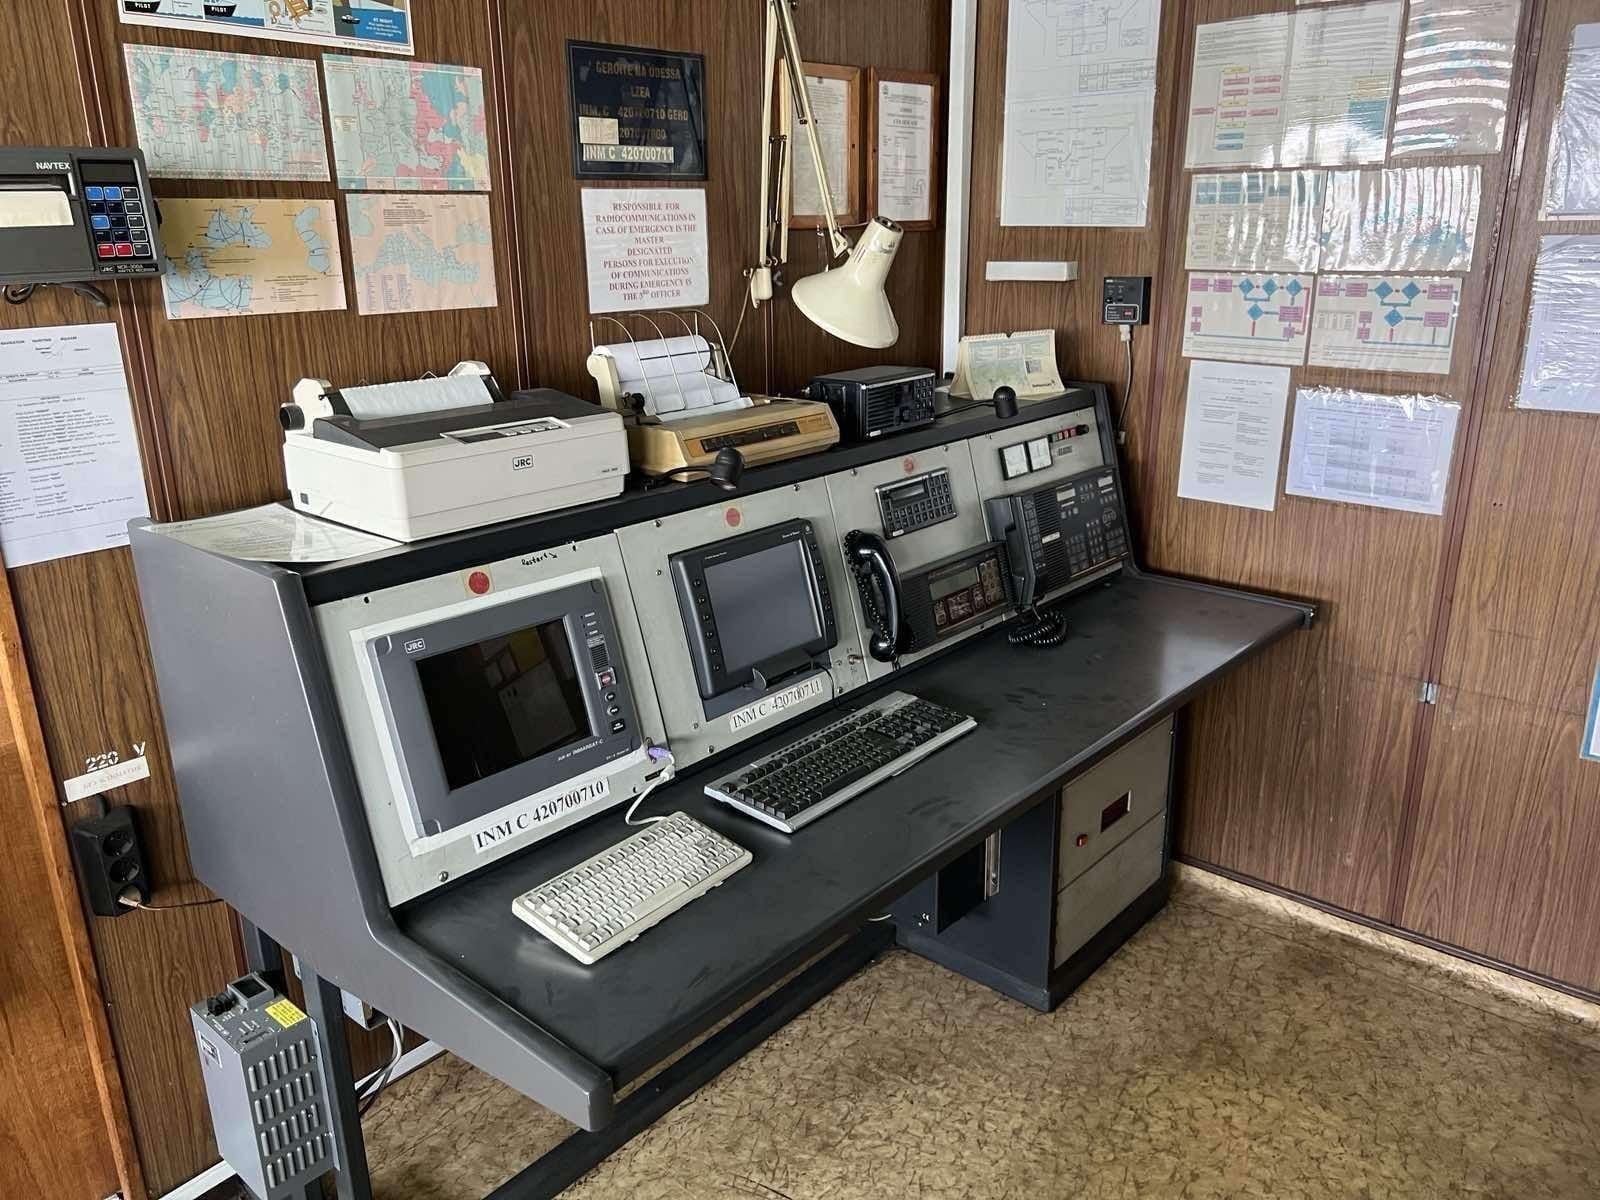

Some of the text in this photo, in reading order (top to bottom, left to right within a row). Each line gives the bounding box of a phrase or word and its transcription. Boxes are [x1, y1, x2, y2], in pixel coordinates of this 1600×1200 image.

[649, 66, 681, 80] ODESSA
[585, 145, 673, 161] INM C 420700711
[35, 162, 72, 170] NAVTEX
[612, 202, 680, 211] RESPONSIBLE FOR
[595, 213, 688, 223] RADIOCOMMUNICATIONS
[595, 223, 696, 235] CASE OF EMERGENCY IS THE
[635, 236, 665, 244] MASTER
[627, 246, 673, 256] DESIGNATED
[603, 256, 695, 268] PERSONS FOR EXECUTION
[611, 267, 689, 280] OF COMMUNICATIONS
[609, 281, 639, 291] DURING
[640, 279, 684, 289] EMERGENCY
[623, 292, 639, 301] THE
[650, 289, 681, 299] OFFICER
[514, 458, 531, 467] JRC
[520, 552, 548, 566] Restart
[407, 641, 423, 651] JRC
[733, 680, 821, 728] INM C 420700711
[85, 741, 146, 773] 220 V
[475, 780, 604, 848] INM C 420700710
